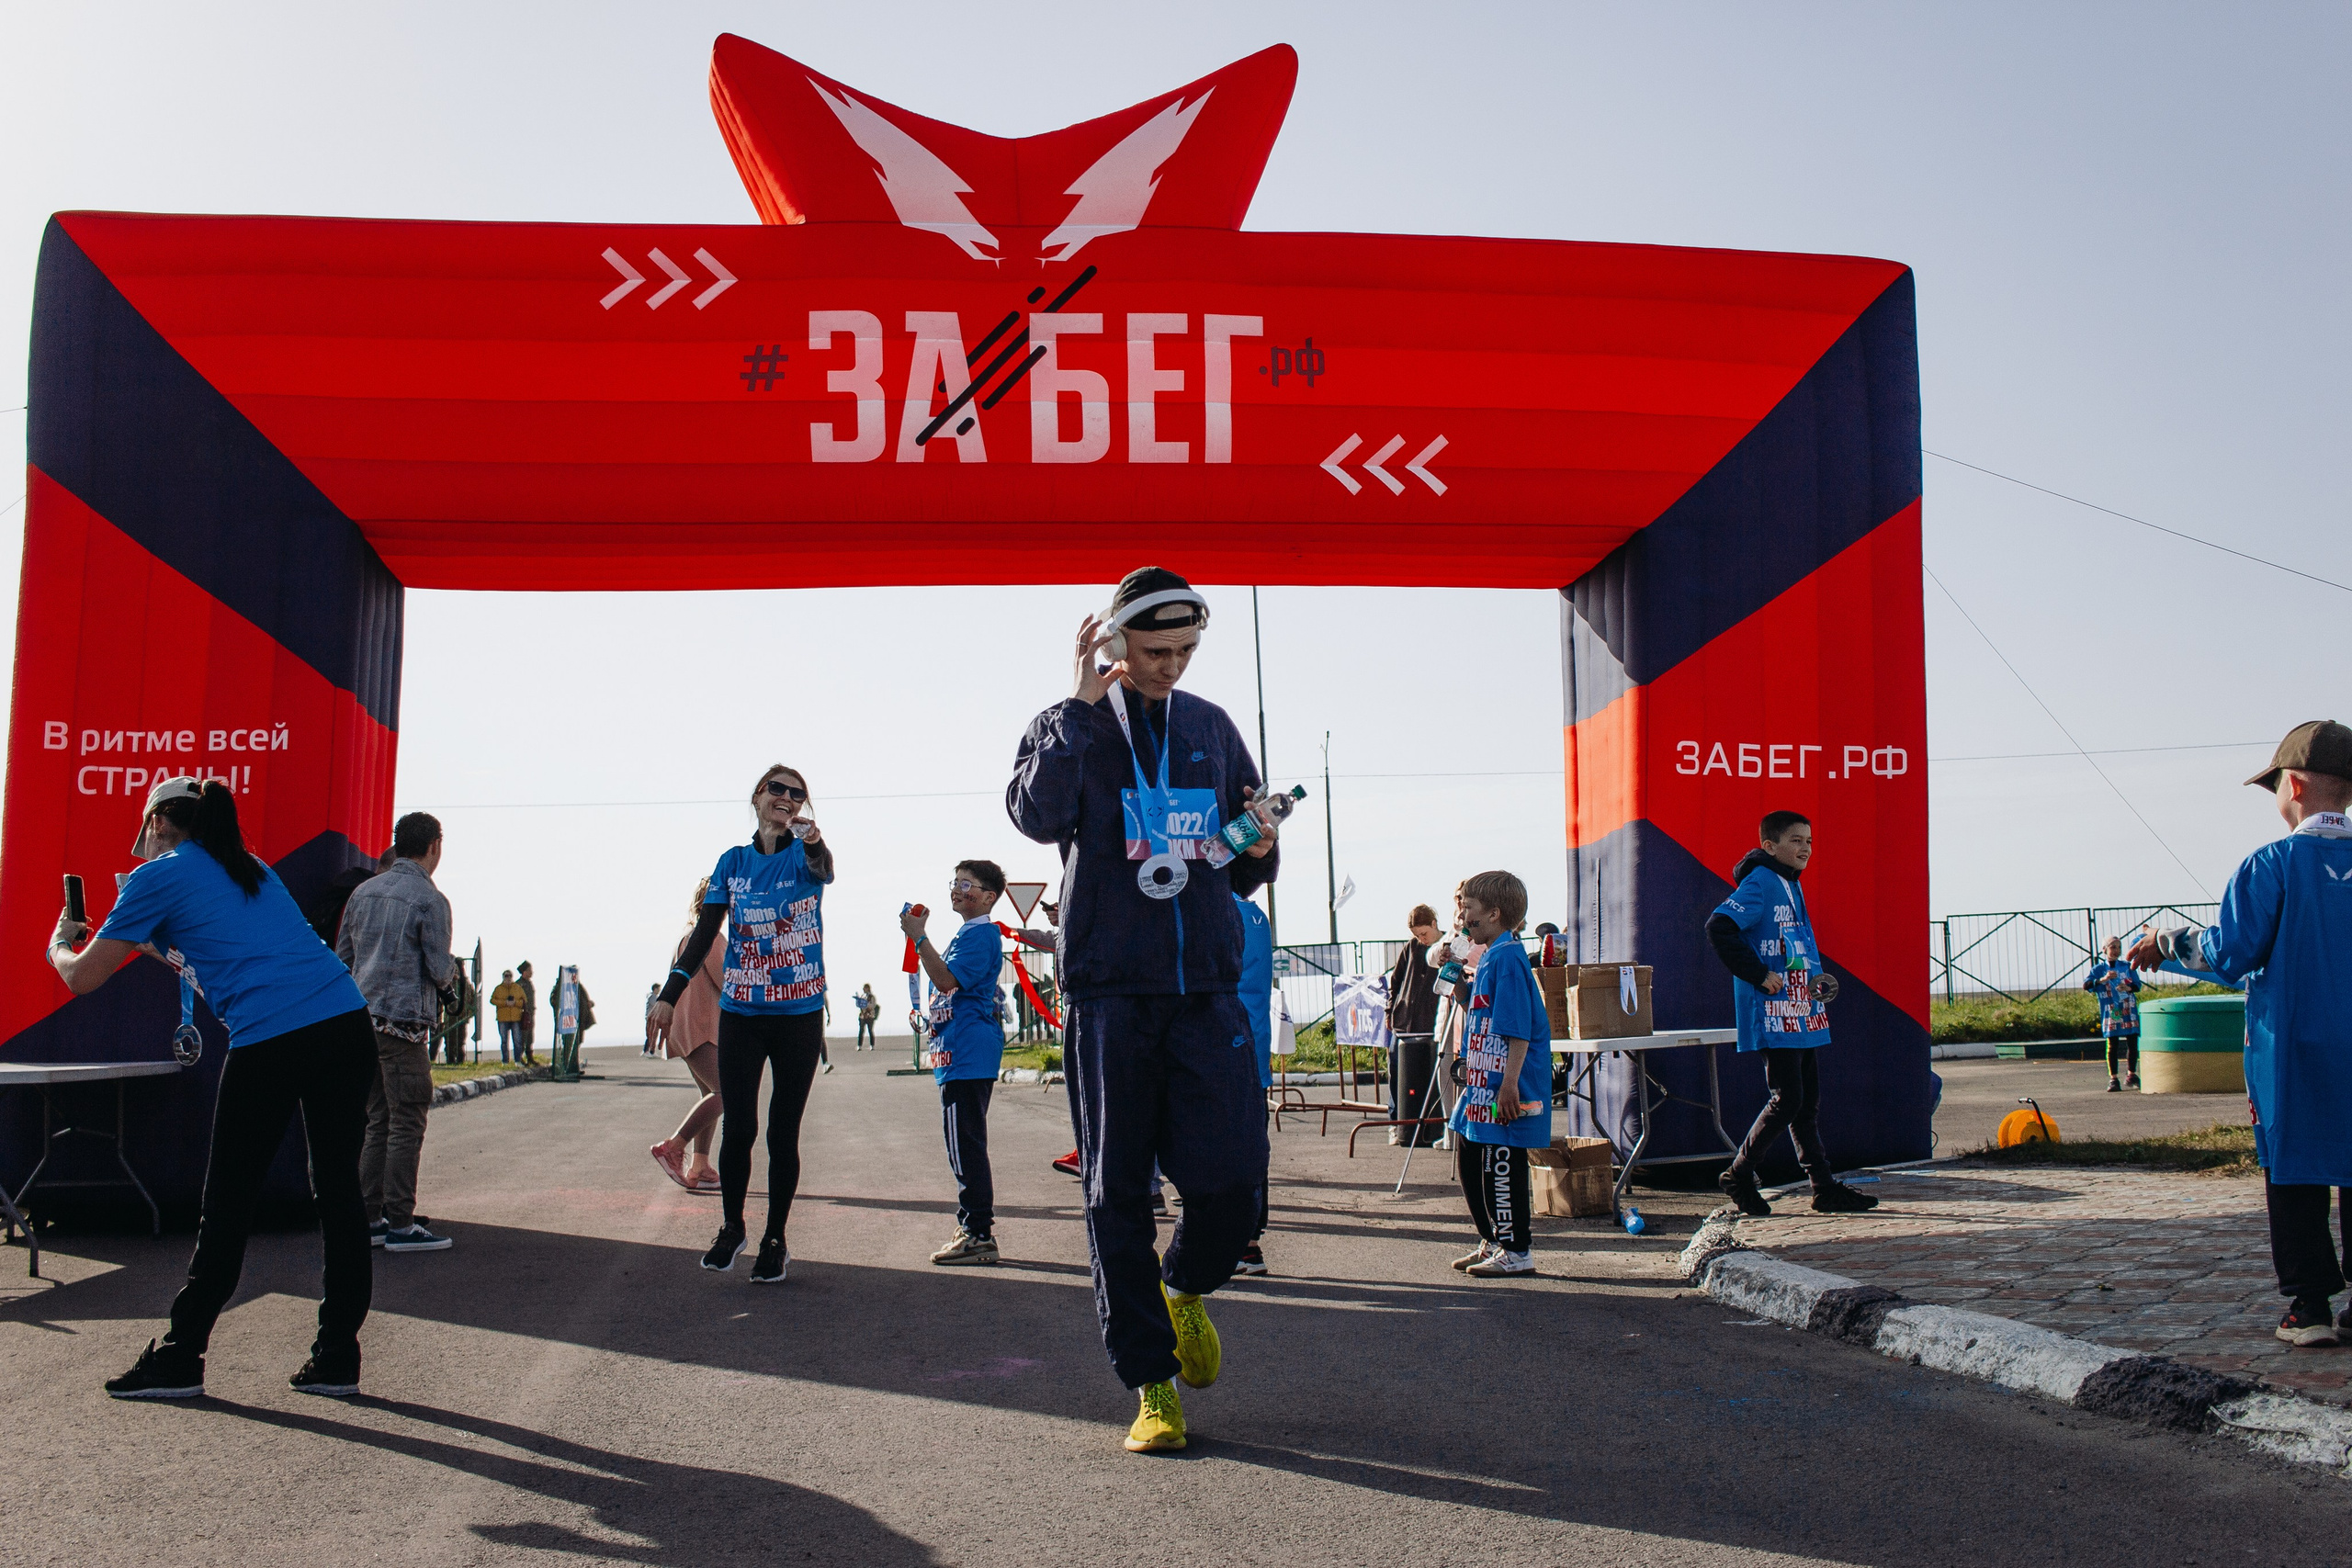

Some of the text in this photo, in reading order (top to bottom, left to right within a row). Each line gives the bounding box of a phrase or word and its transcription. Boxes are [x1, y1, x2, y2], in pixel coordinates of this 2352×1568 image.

[43, 721, 289, 756] В ритме всей
[1675, 739, 1908, 779] ЗАБЕГ.РФ
[1167, 812, 1204, 835] 022
[743, 908, 777, 922] 30016
[793, 961, 820, 983] 2024
[1494, 1145, 1515, 1243] COMMENT
